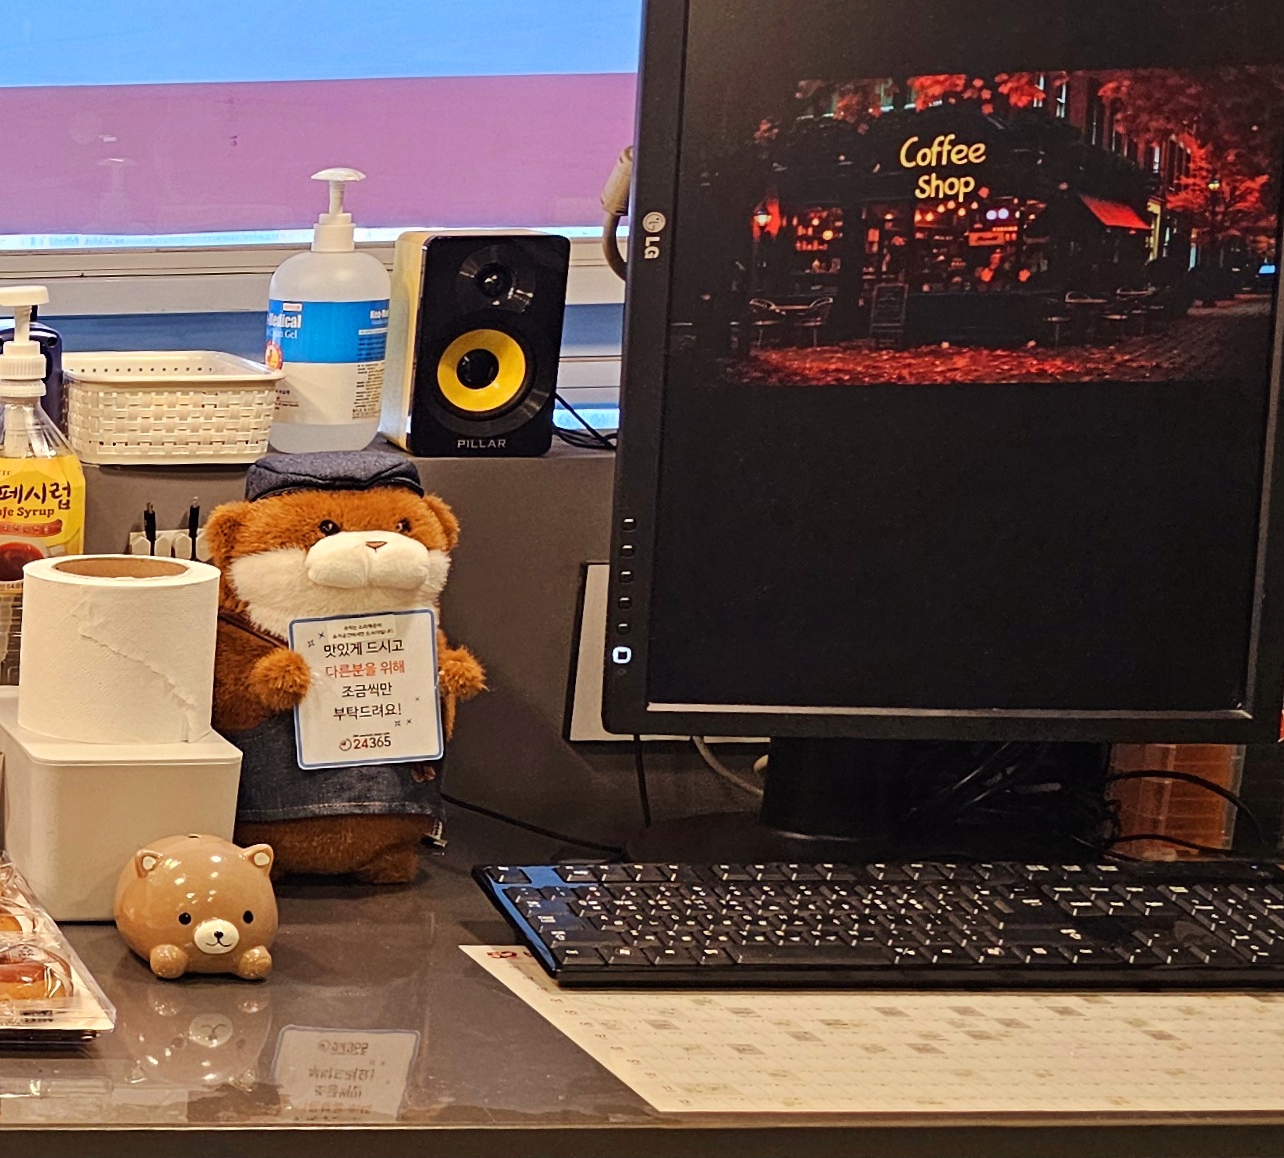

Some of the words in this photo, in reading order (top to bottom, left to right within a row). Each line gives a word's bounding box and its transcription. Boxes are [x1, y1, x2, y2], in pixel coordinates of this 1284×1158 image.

[900, 134, 987, 168] Coffee
[914, 172, 975, 203] Shop
[644, 236, 660, 259] LG
[457, 439, 506, 448] PILLAR
[16, 507, 55, 518] Syrup
[324, 642, 362, 658] 맛있게
[365, 640, 404, 654] 드시고
[325, 662, 377, 679] 다른분을
[380, 660, 405, 675] 위해
[341, 682, 393, 699] 조금씩만
[333, 703, 402, 721] 부탁드려요!
[353, 736, 391, 750] 24365
